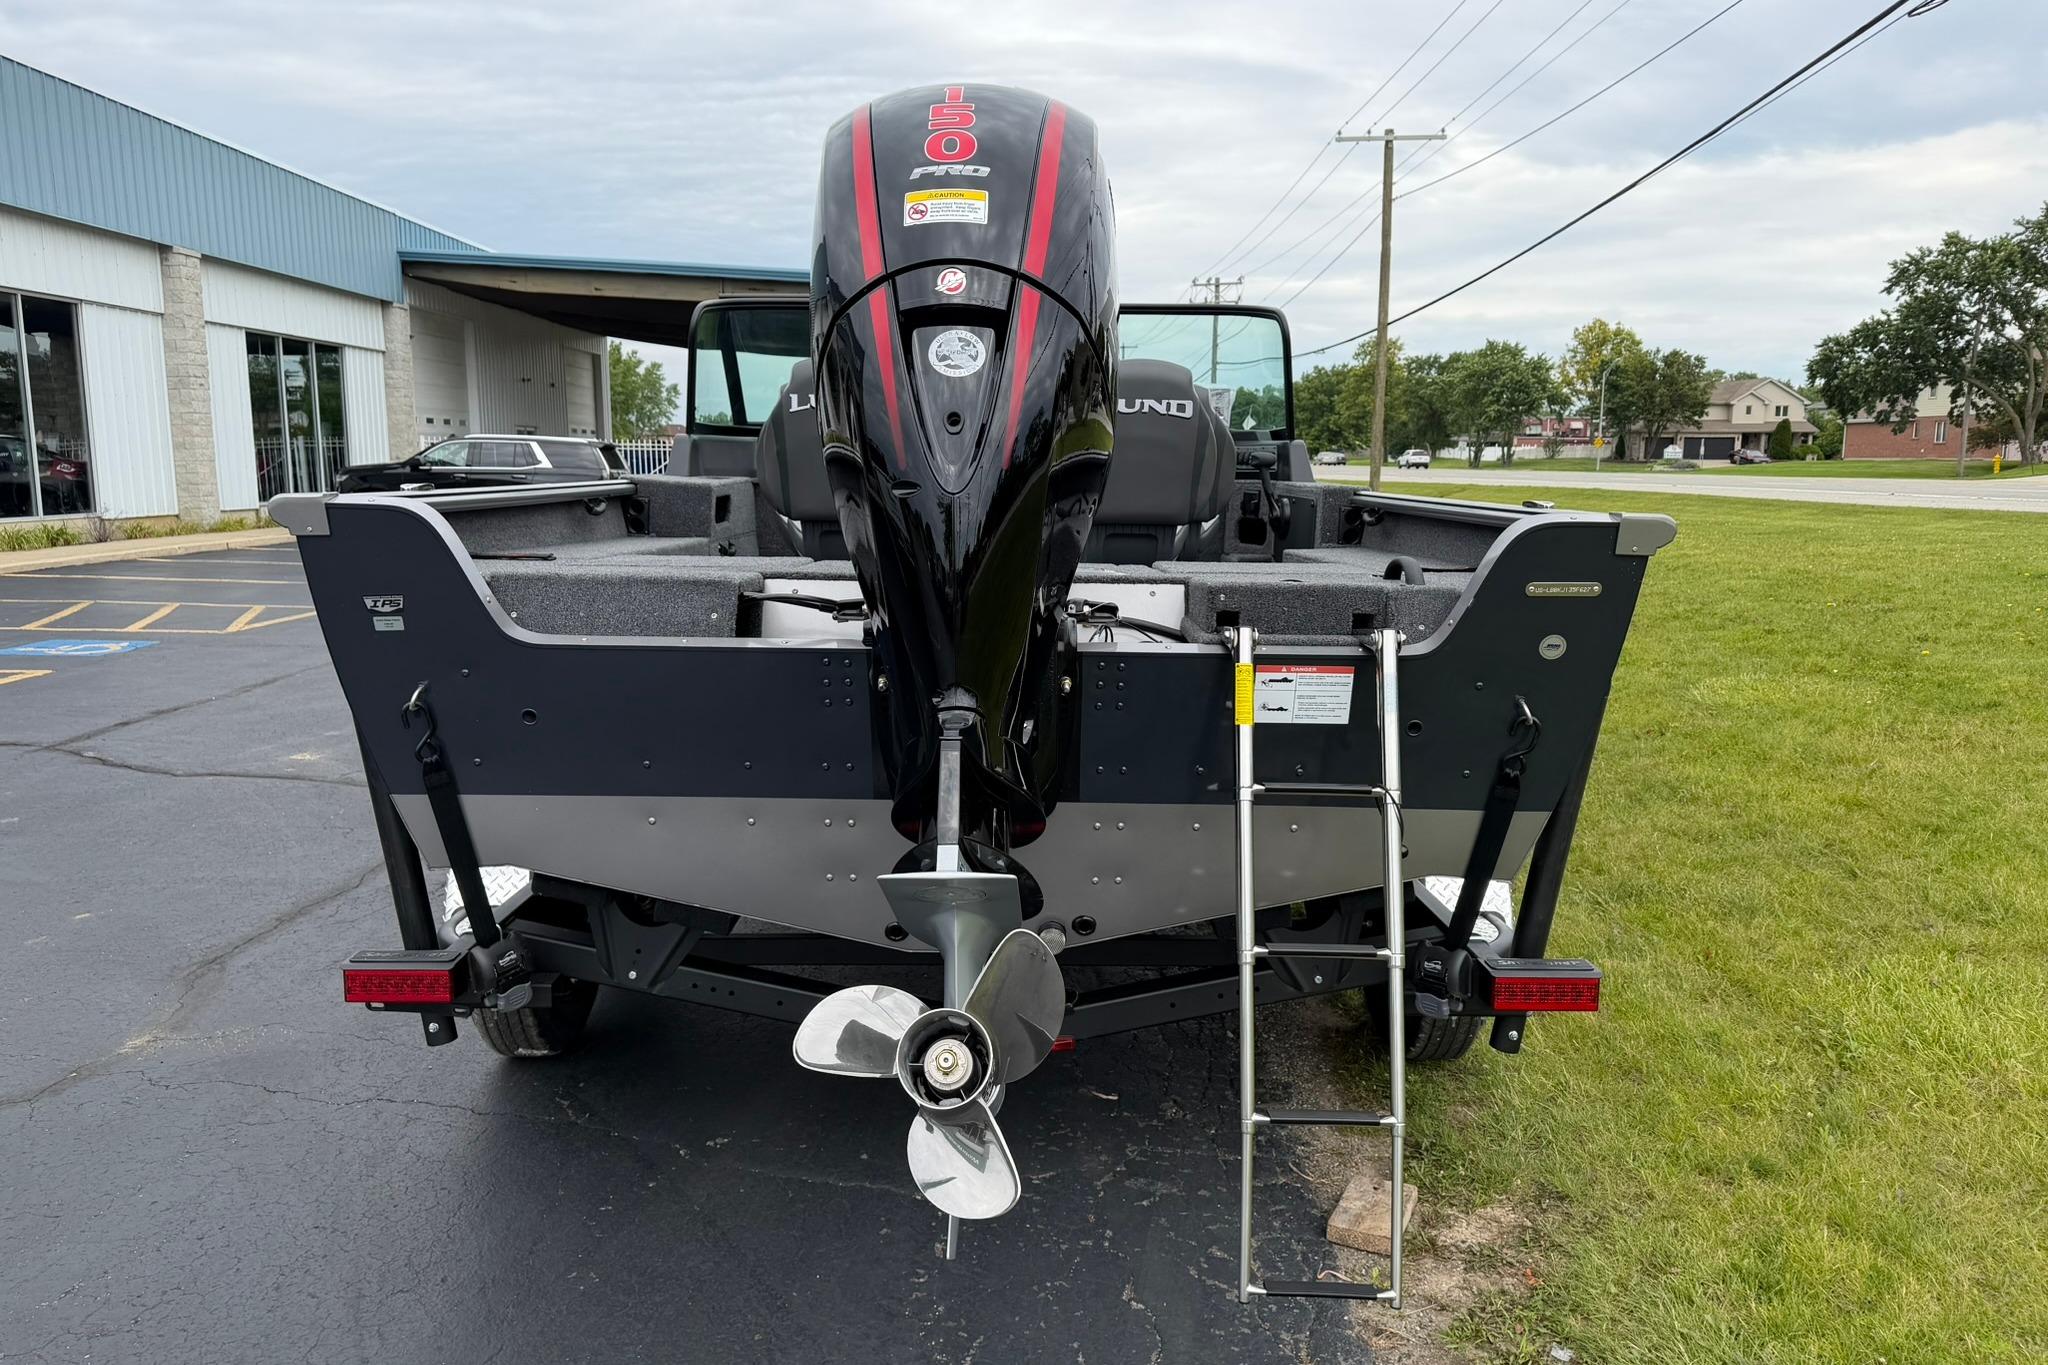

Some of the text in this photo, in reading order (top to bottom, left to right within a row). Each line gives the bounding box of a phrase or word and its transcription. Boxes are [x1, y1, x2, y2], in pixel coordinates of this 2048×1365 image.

[924, 86, 978, 163] 150
[909, 164, 991, 180] PRO
[1117, 398, 1194, 418] UND
[369, 599, 402, 608] IPS
